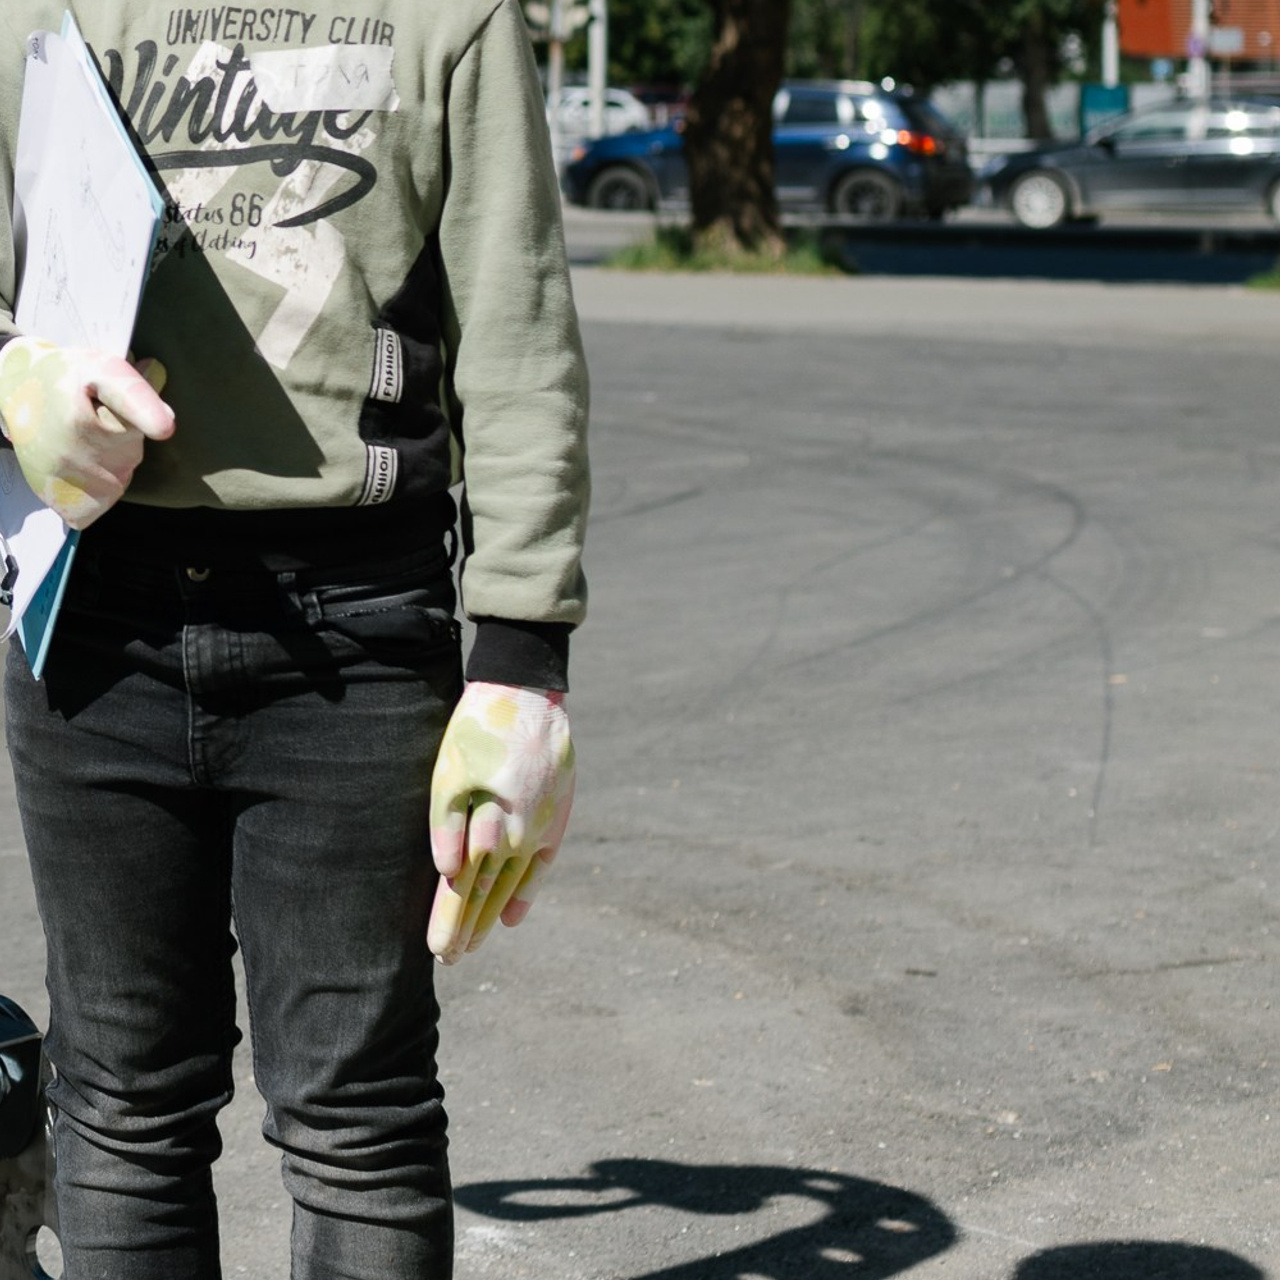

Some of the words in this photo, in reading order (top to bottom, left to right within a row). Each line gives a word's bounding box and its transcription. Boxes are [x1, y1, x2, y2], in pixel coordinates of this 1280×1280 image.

[166, 6, 317, 46] UNIVERSITY
[328, 16, 395, 47] CLUB
[229, 192, 265, 227] 86
[371, 450, 389, 504] ASHION
